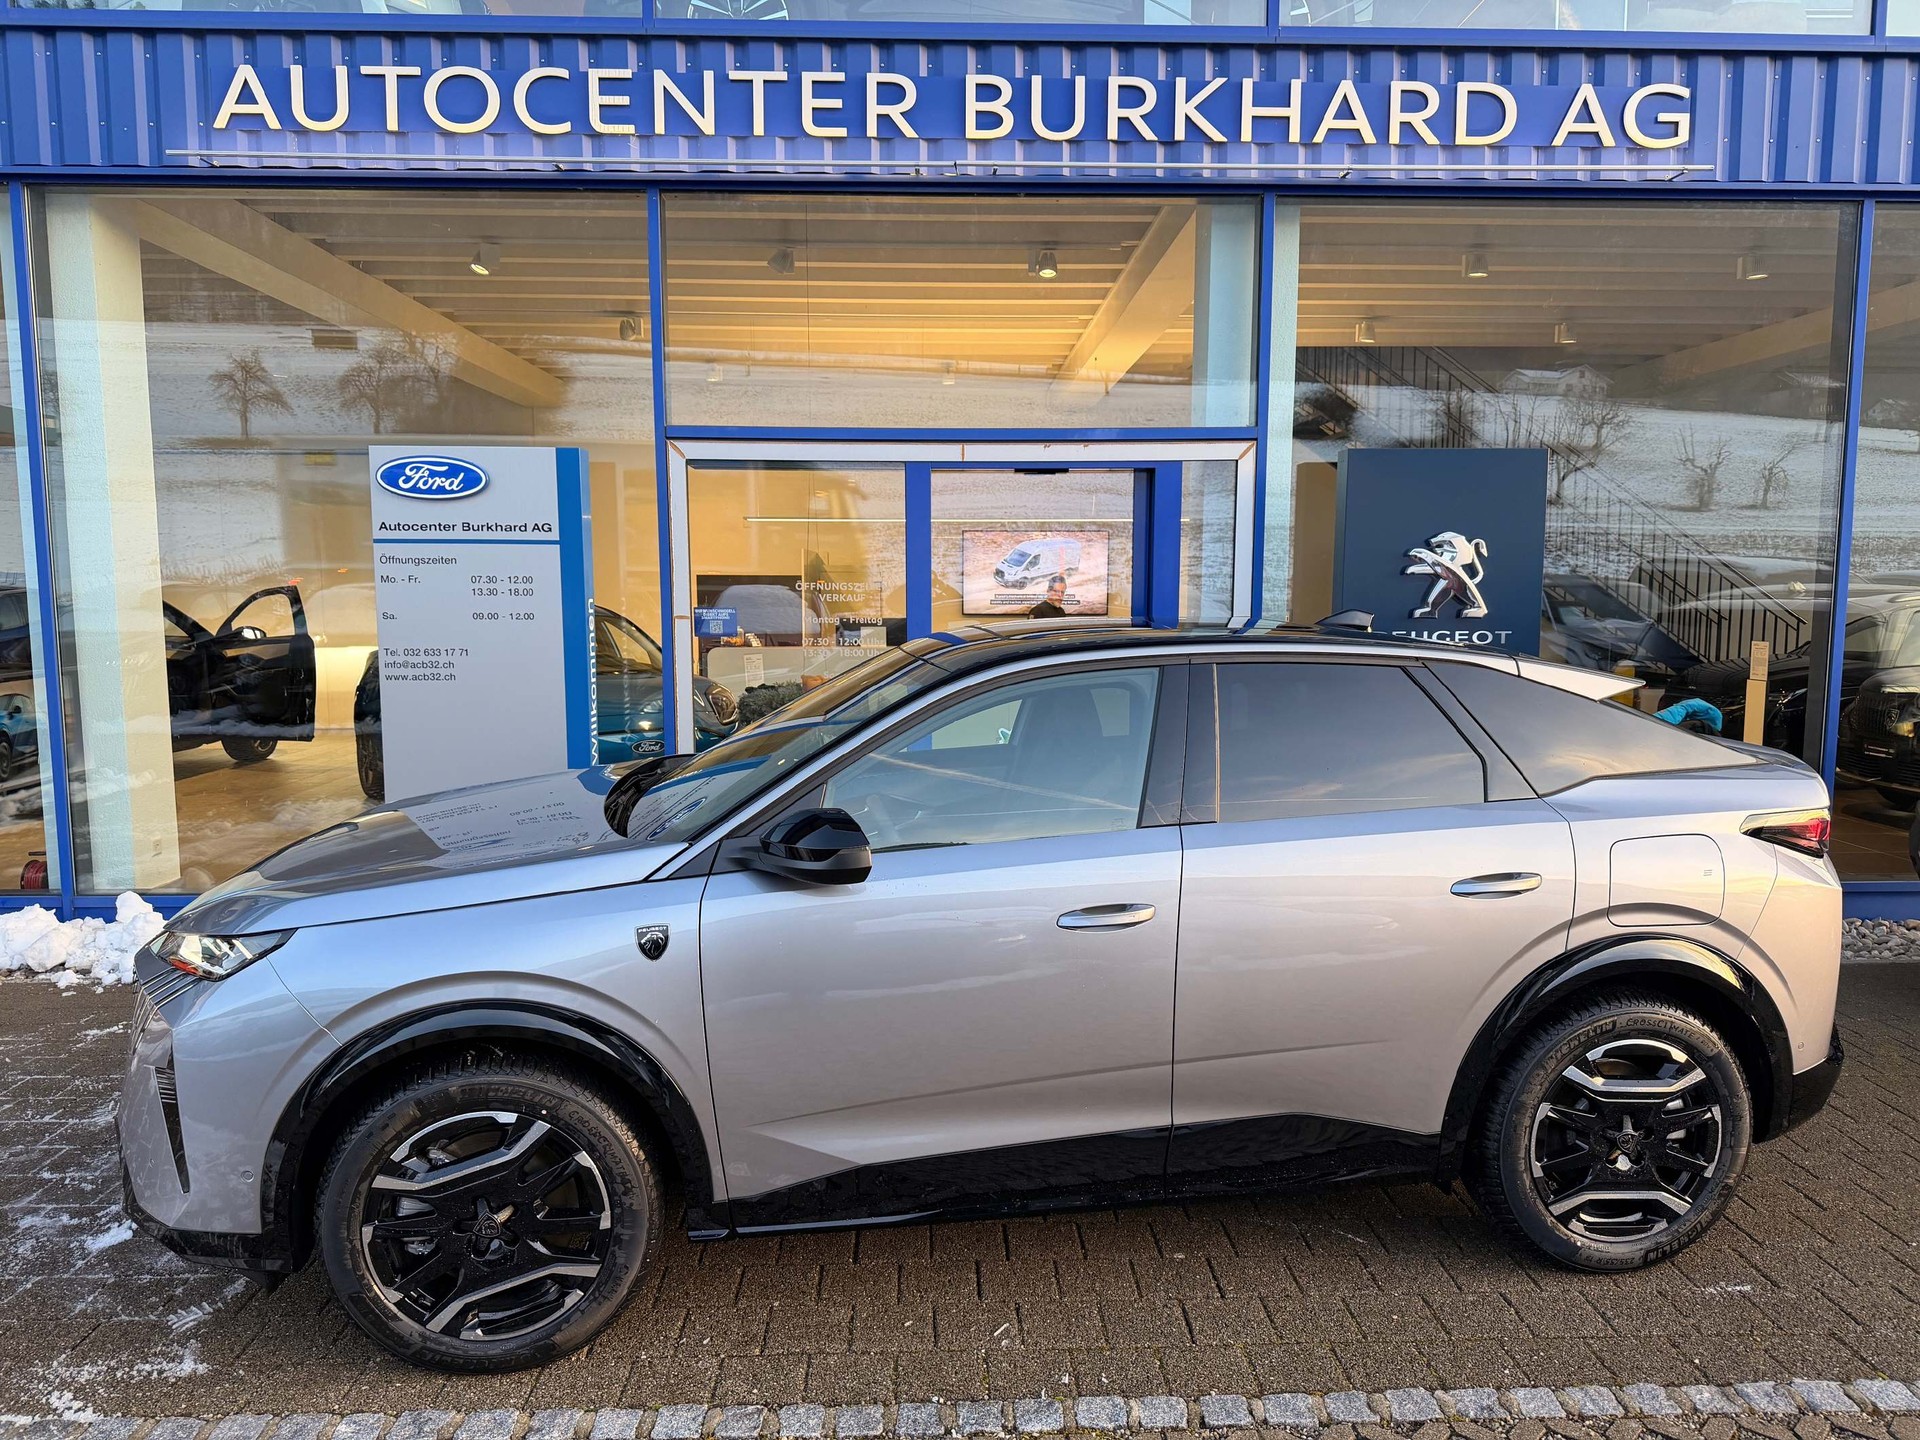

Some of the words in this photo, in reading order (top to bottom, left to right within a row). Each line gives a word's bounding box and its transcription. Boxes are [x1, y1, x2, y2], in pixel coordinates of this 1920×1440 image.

[211, 63, 920, 140] AUTOCENTER
[964, 73, 1519, 148] BURKHARD
[1552, 82, 1692, 151] AG
[398, 463, 464, 491] Ford
[378, 521, 457, 532] Autocenter
[462, 521, 528, 533] Burkhard
[531, 522, 553, 533] AG
[379, 553, 457, 566] Öffnungszeiten
[380, 575, 399, 584] Mo.
[408, 575, 421, 584] Fr.
[470, 575, 498, 585] 07.30
[508, 576, 534, 585] 12.00
[471, 588, 499, 597] 13.30
[508, 588, 534, 597] 18.00
[819, 594, 866, 602] VERKAUF
[382, 611, 398, 620] Sa.
[472, 612, 499, 621] 09.00
[509, 612, 535, 621] 12.00
[850, 616, 883, 626] Freitag
[802, 637, 829, 646] 07:30
[838, 637, 864, 646] 12:00
[384, 648, 401, 657] Tel.
[403, 649, 422, 657] 032
[423, 649, 442, 657] 633
[444, 649, 457, 657] 17
[458, 649, 469, 657] 71
[839, 649, 864, 657] 18:00
[384, 660, 455, 669] info@acb32.ch
[384, 673, 456, 681] www.acb32.ch
[588, 598, 598, 766] Willkommen
[638, 741, 661, 752] Ford
